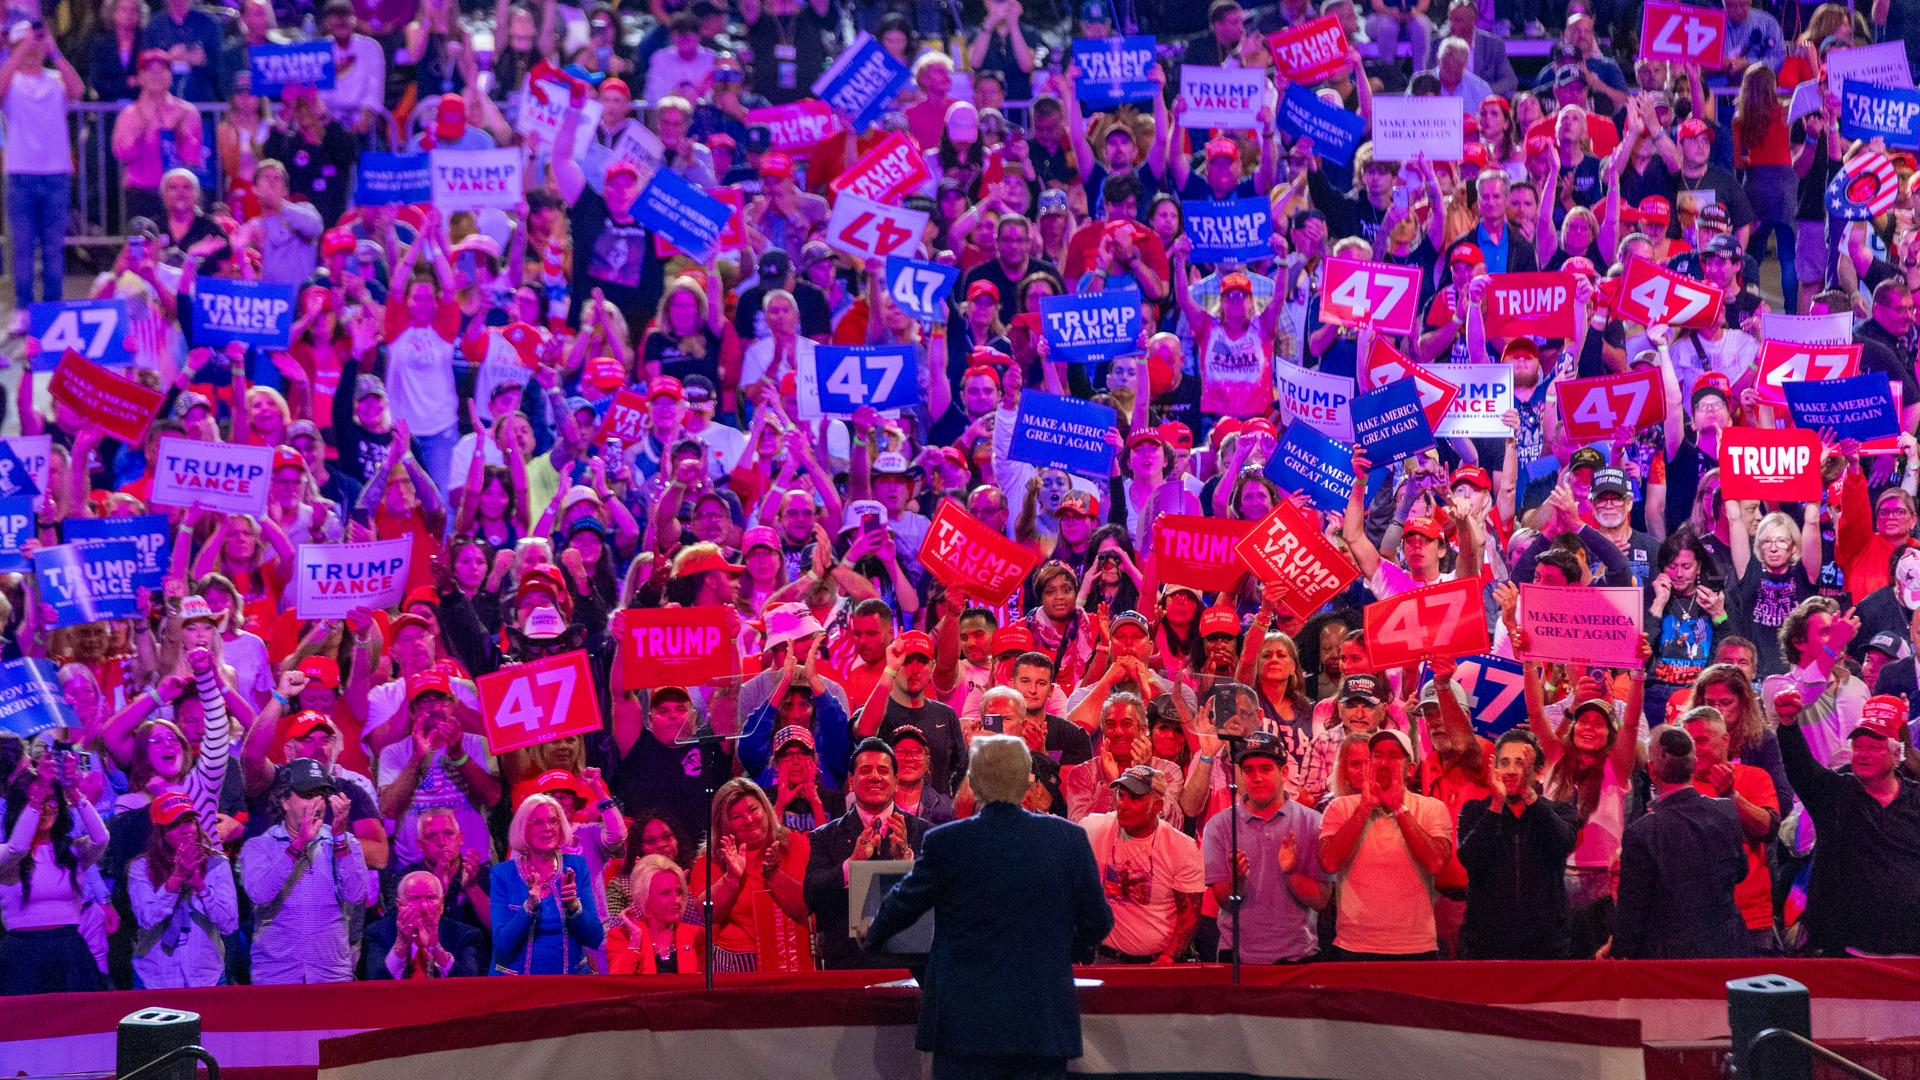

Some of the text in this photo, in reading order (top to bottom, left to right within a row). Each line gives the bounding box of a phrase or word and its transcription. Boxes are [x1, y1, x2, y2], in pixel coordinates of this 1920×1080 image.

[1277, 27, 1341, 58] TRUMP
[1653, 15, 1716, 55] 47
[1079, 51, 1150, 66] TRUMP
[1087, 64, 1146, 79] VANCE
[1286, 46, 1340, 71] VANCE
[831, 51, 884, 110] TRUMP
[1186, 82, 1258, 97] TRUMP
[1194, 97, 1249, 109] VANCE
[1846, 92, 1919, 119] TRUMP
[1378, 118, 1457, 129] MAKE AMERICA
[1853, 108, 1911, 129] VANCE
[1384, 130, 1451, 139] GREAT AGAIN
[438, 165, 515, 179] TRUMP
[447, 181, 506, 191] VANCE
[840, 212, 912, 256] 47
[1189, 212, 1266, 231] TRUMP
[1199, 228, 1259, 244] VANCE
[200, 293, 289, 314] TRUMP
[893, 267, 945, 314] 47
[1331, 271, 1409, 320] 47
[1495, 286, 1566, 315] TRUMP
[1631, 275, 1711, 324] 47
[207, 309, 278, 330] VANCE
[1048, 306, 1136, 330] TRUMP
[41, 309, 118, 359] 47
[1059, 323, 1127, 341] VANCE
[826, 355, 903, 403] 47
[1766, 353, 1849, 387] 47
[62, 379, 138, 423] GREAT AGAIN
[63, 365, 150, 416] MAKE AMERICA
[1280, 376, 1346, 408] TRUMP
[1456, 383, 1506, 400] UMP
[614, 404, 653, 429] TRU
[1284, 395, 1337, 421] VANCE
[1452, 400, 1496, 413] NCE
[1572, 380, 1650, 429] 47
[1794, 395, 1887, 414] MAKE AMERICA
[1803, 409, 1883, 424] GREAT AGAIN
[1022, 413, 1106, 439] MAKE AMERIC
[1357, 402, 1419, 434] MAKE AMERICA
[1025, 429, 1104, 453] GREAT AGAIN
[1362, 417, 1419, 446] GREAT AGAIN
[166, 456, 264, 480] TRUMP
[1050, 461, 1068, 470] 2024
[1284, 440, 1369, 495] MAKE AMERIA
[1392, 452, 1407, 461] 2024
[1728, 446, 1810, 476] TRUMP
[175, 472, 251, 494] VANCE
[1284, 456, 1352, 501] GREAT AGAI
[938, 518, 1023, 578] TRUMP
[1264, 516, 1340, 592] TRUMP
[44, 560, 137, 586] TRUMP
[307, 558, 404, 580] TRUMP
[939, 540, 1004, 587] VANCE
[1252, 543, 1267, 560] MAKE
[1265, 558, 1286, 581] AMERICA
[1262, 537, 1322, 597] VANCE
[58, 577, 132, 603] VANCE
[317, 575, 393, 595] VANCE
[1377, 589, 1467, 650] 47
[1528, 610, 1635, 627] MAKE AMERICA
[1753, 610, 1784, 627] TRU
[632, 626, 721, 657] TRUMP
[1534, 626, 1627, 641] GREAT AGAIN
[1347, 678, 1376, 687] Trump
[1453, 661, 1525, 723] 47
[495, 665, 577, 733] 47
[537, 730, 557, 740] 2024
[774, 904, 786, 957] AMERIC
[788, 946, 799, 972] EAT
